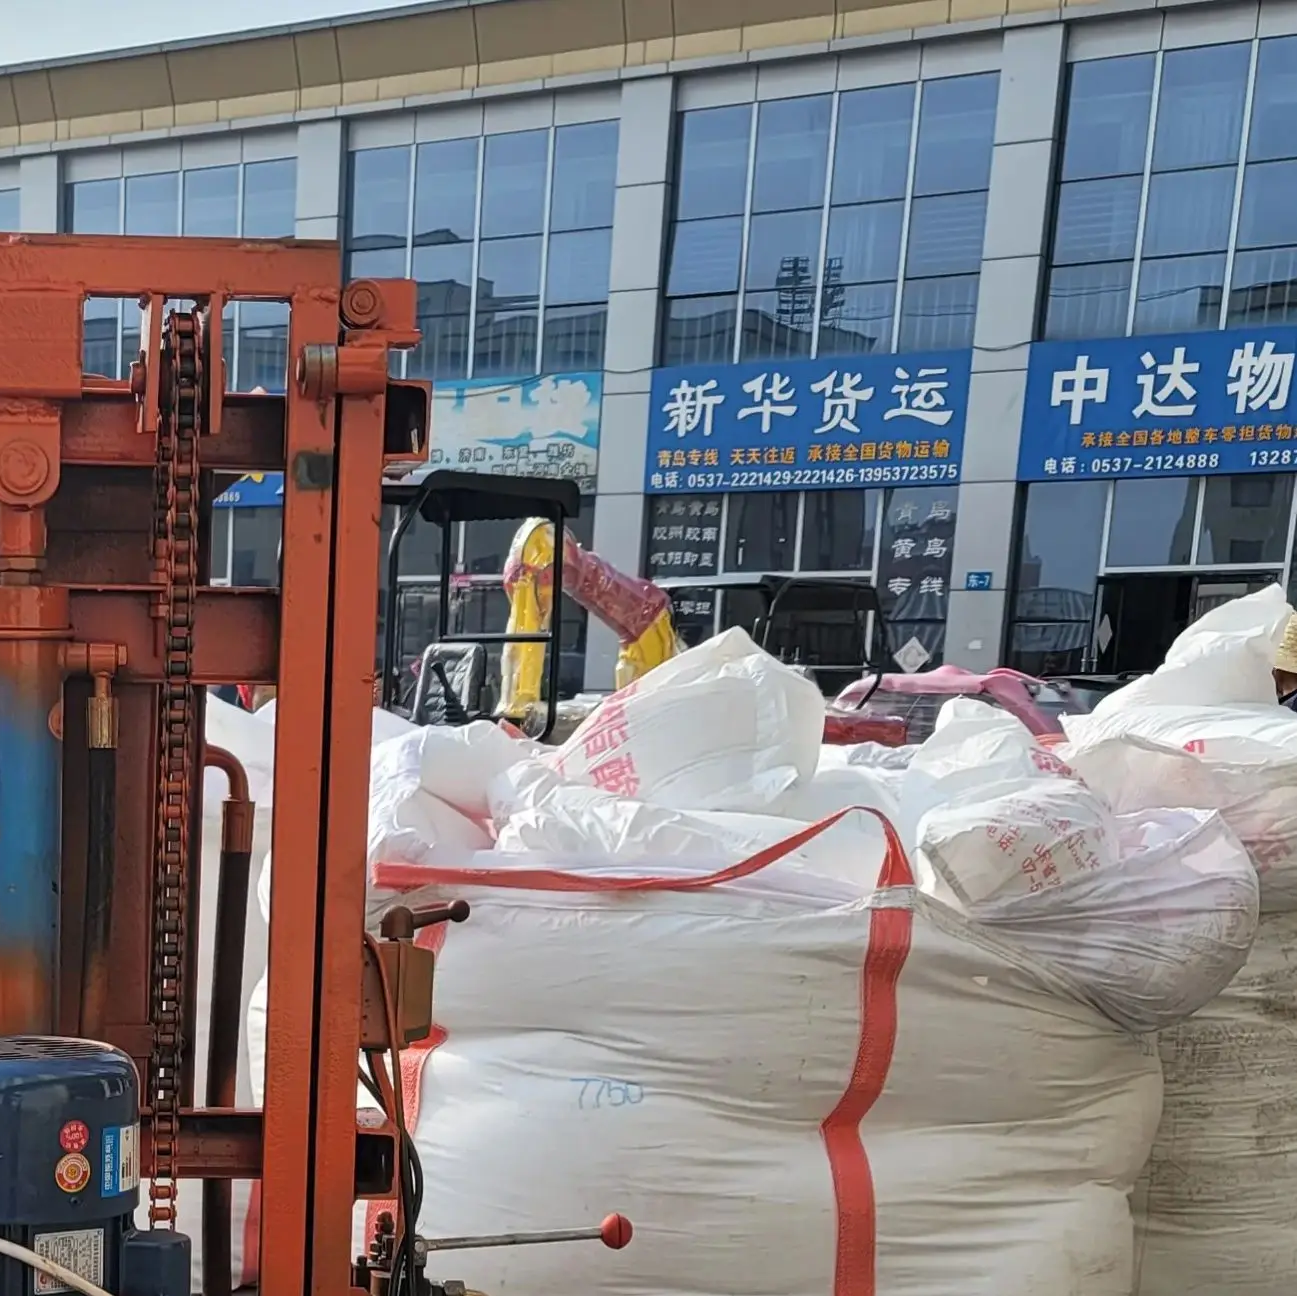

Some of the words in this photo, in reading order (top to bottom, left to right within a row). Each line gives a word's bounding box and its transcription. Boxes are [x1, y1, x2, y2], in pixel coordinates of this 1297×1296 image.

[1050, 341, 1296, 425] 中达物
[662, 367, 954, 438] 新华货运
[1081, 424, 1297, 449] 承接全国各地整车零担货物
[657, 448, 719, 468] 青岛专线
[730, 447, 796, 466] 天天往返
[807, 440, 951, 463] 承接全国货物运输
[1091, 453, 1219, 474] 0537-2124888
[891, 537, 947, 558] 黄岛
[887, 576, 944, 596] 专线
